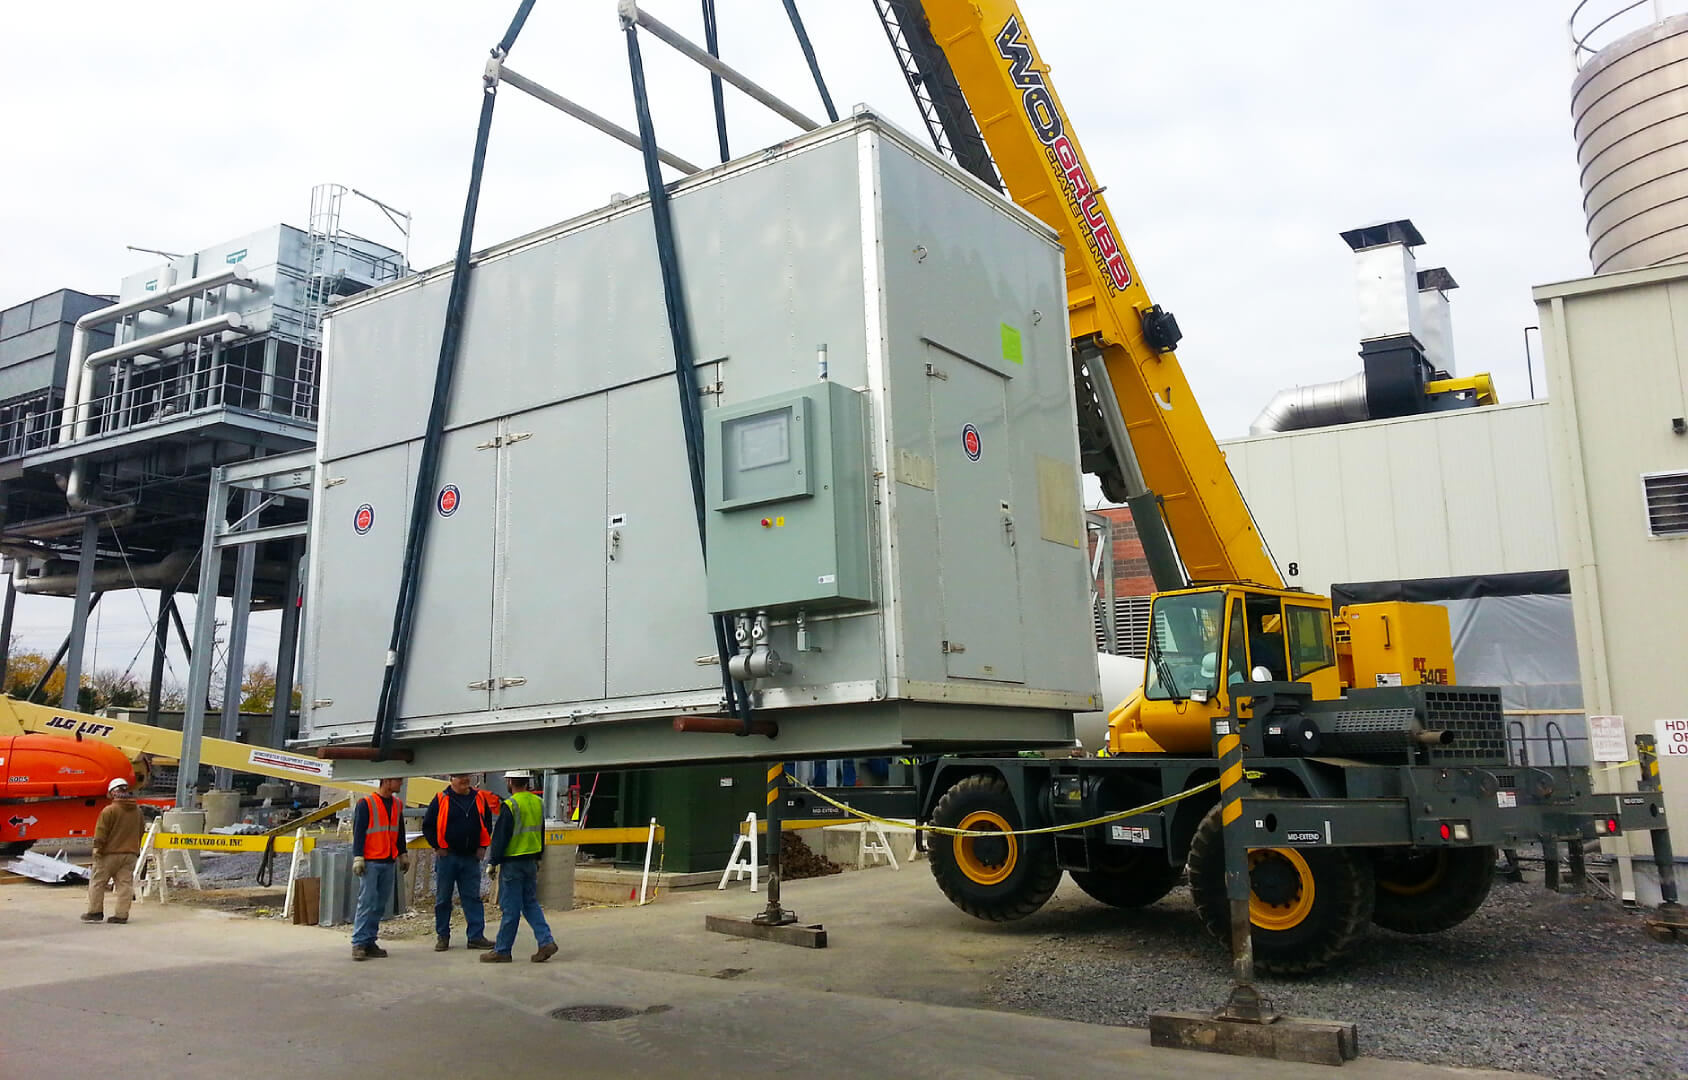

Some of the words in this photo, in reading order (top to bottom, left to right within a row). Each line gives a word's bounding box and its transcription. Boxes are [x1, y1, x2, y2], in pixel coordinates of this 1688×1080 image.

[1053, 135, 1132, 292] GRUBB
[1045, 146, 1081, 218] CRANE
[1078, 219, 1117, 299] RENTAL
[1288, 562, 1299, 576] 8
[1413, 657, 1426, 671] RT
[46, 716, 76, 730] JLG
[77, 722, 114, 737] LIFT
[1665, 720, 1688, 731] HD
[1287, 833, 1320, 841] MID-EXTEND
